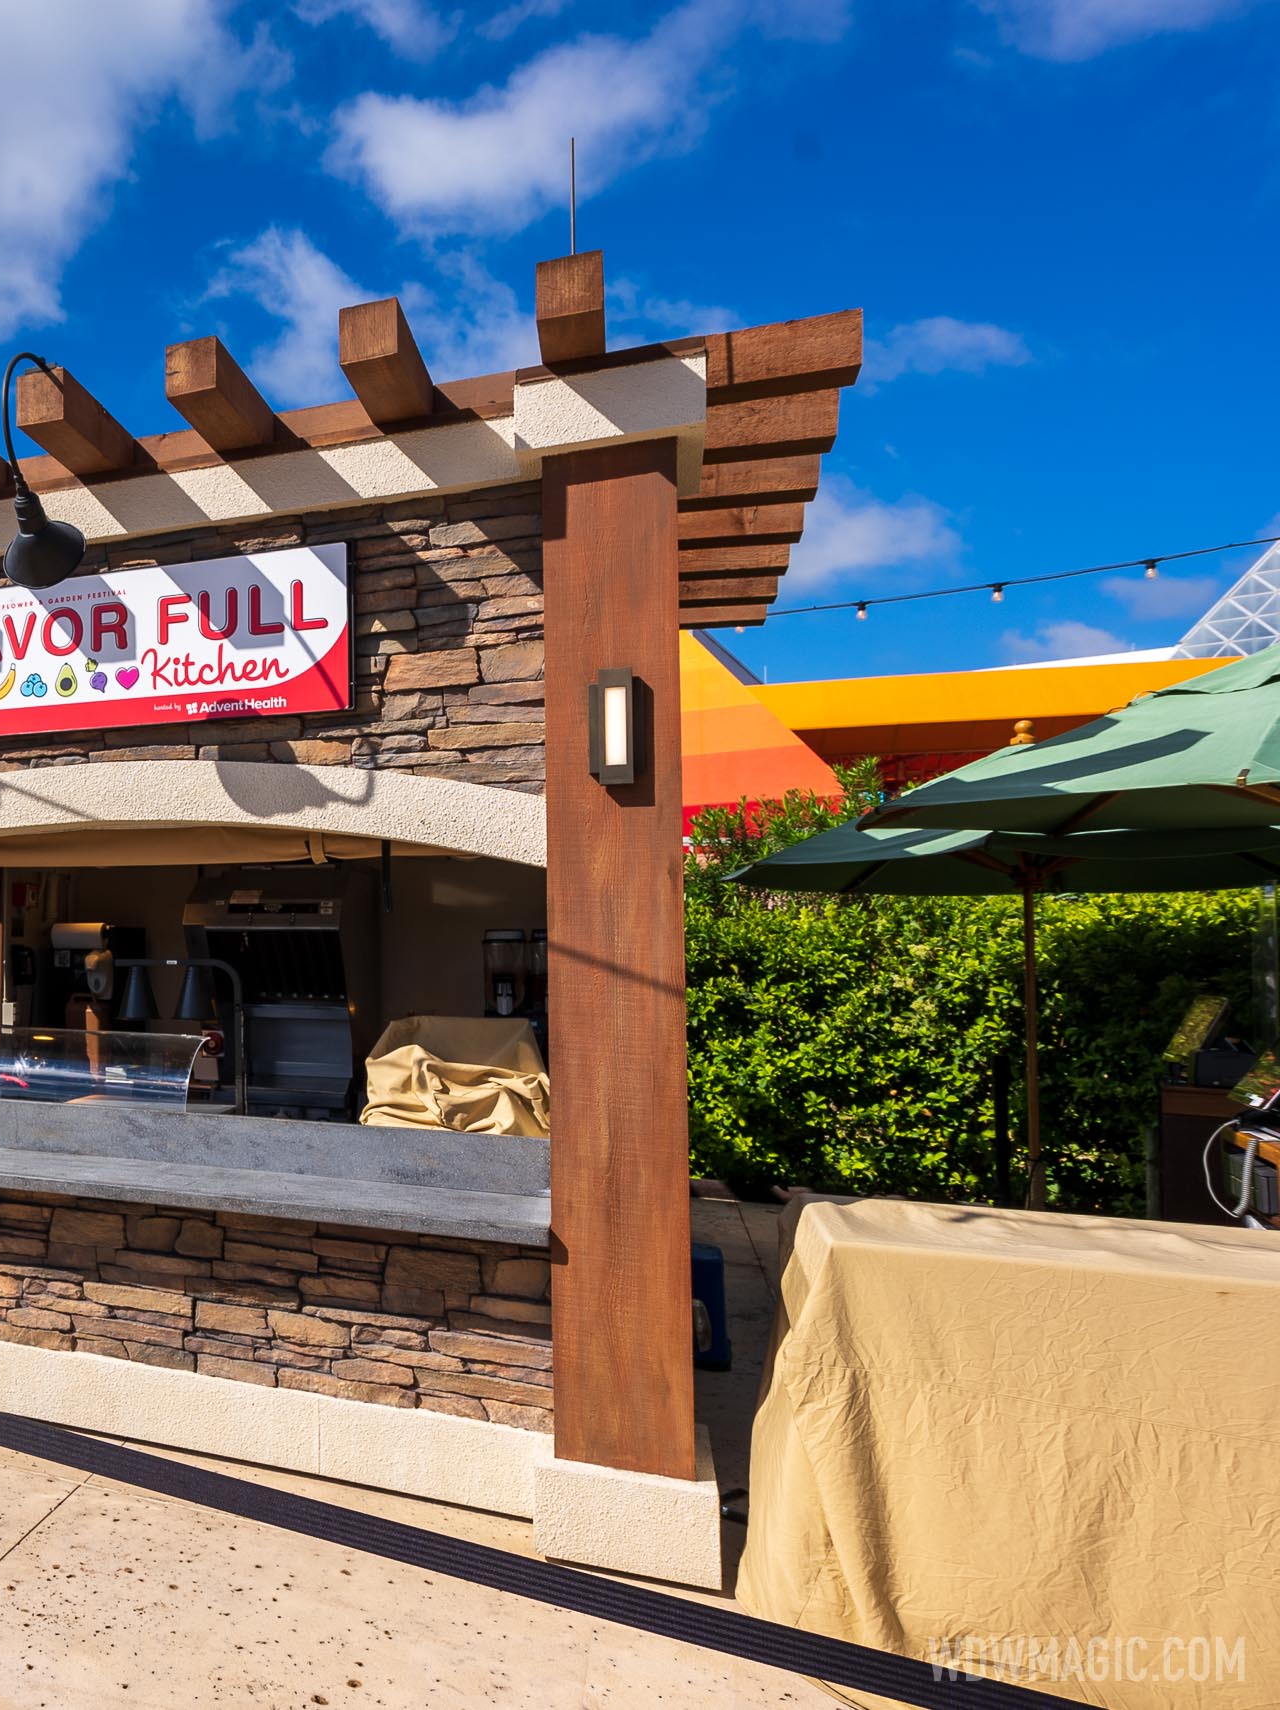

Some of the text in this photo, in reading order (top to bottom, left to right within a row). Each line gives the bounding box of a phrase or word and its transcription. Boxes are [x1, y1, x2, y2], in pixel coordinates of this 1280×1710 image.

[1, 600, 34, 610] FLOWER
[48, 595, 83, 604] GARDEN
[87, 590, 127, 600] FESTIVAL
[157, 579, 329, 645] FULL
[141, 643, 290, 690] Kitchen
[153, 696, 287, 713] hosted by AdventHealth
